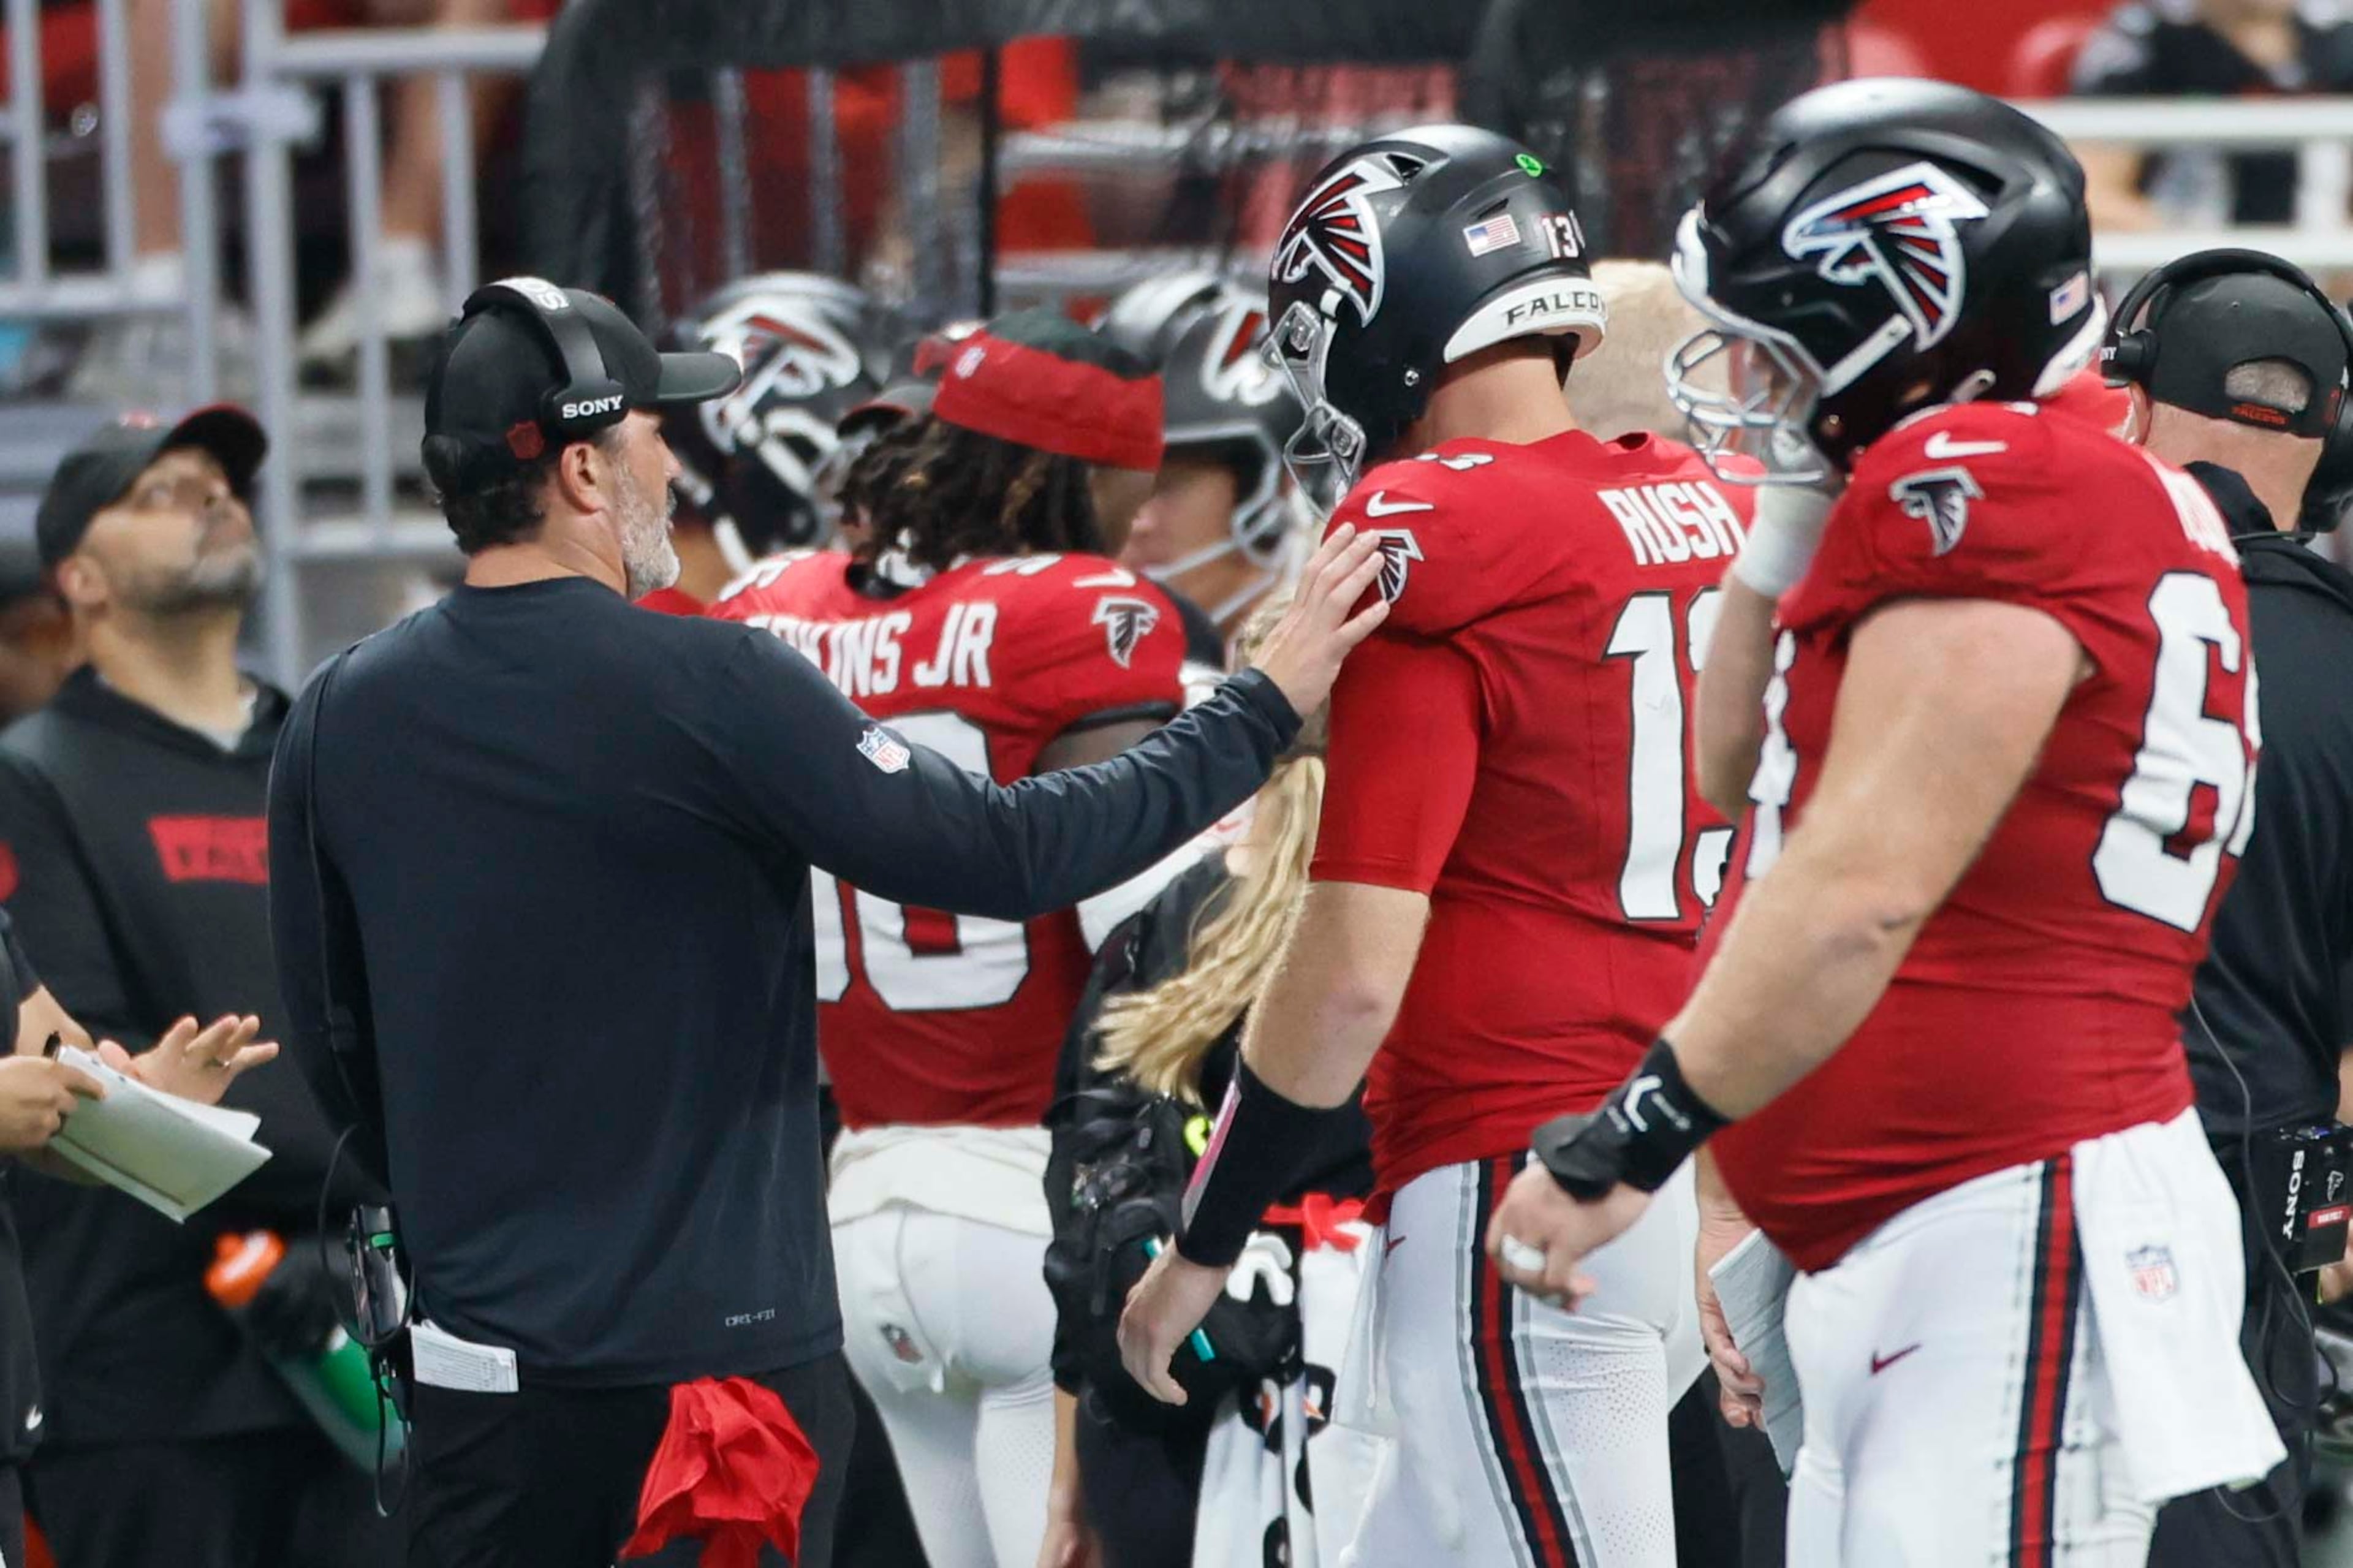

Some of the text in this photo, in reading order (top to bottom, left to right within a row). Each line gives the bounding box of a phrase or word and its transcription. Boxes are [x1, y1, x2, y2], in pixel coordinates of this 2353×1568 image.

[1506, 290, 1607, 320] FALCO
[562, 395, 623, 419] SONY
[1596, 480, 1748, 566] RUSH
[748, 603, 998, 697] KINS JR
[2093, 571, 2262, 934] 6
[2283, 1150, 2305, 1240] SONY
